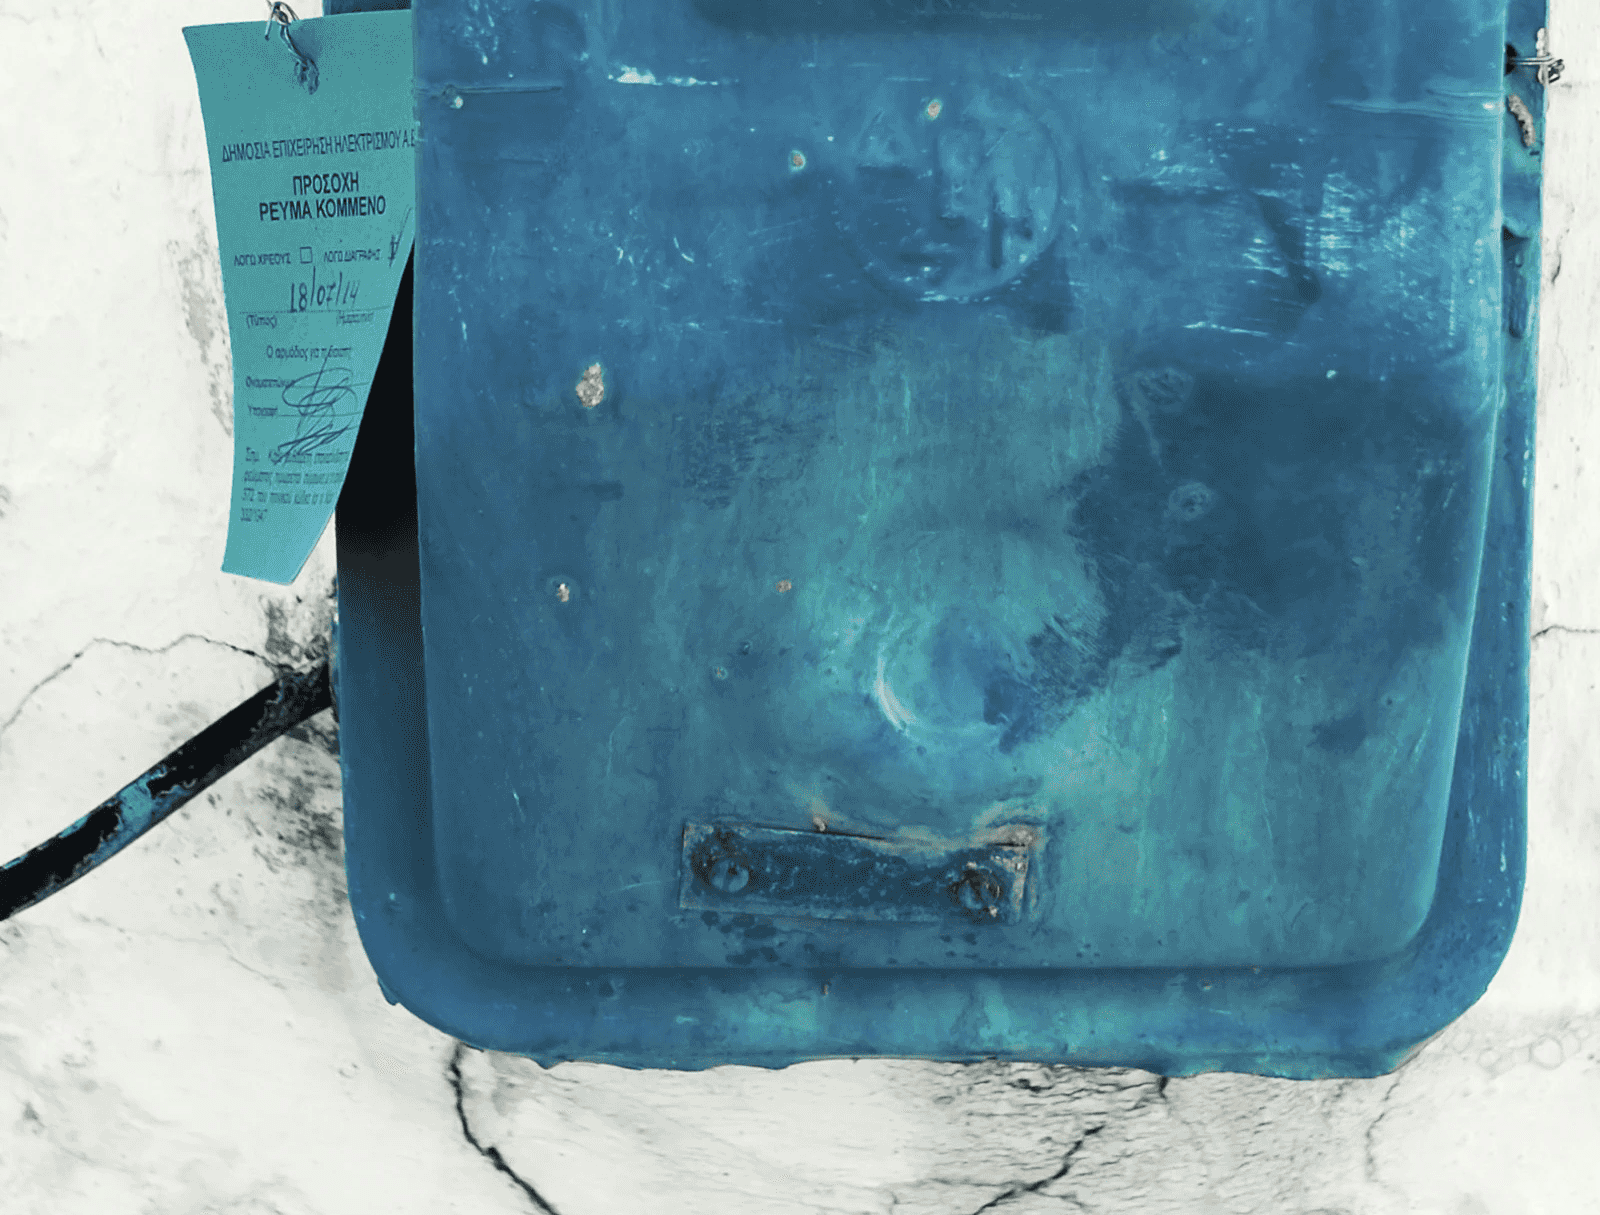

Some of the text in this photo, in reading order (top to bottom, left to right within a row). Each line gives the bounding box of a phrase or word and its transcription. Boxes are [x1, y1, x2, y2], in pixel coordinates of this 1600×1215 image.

[222, 141, 271, 162] ΔΗΜΟΣΙΑ
[272, 136, 333, 159] ΕΠΙΧΕΙΡΗΣΗ
[334, 129, 402, 154] ΗΛΕΚΤΡΙΣΜΟΥ
[292, 171, 360, 196] ΠΡΟΣΟΧΗ
[259, 195, 386, 221] ΡΕΥΜΑ ΚΟΜΜΕΝΟ
